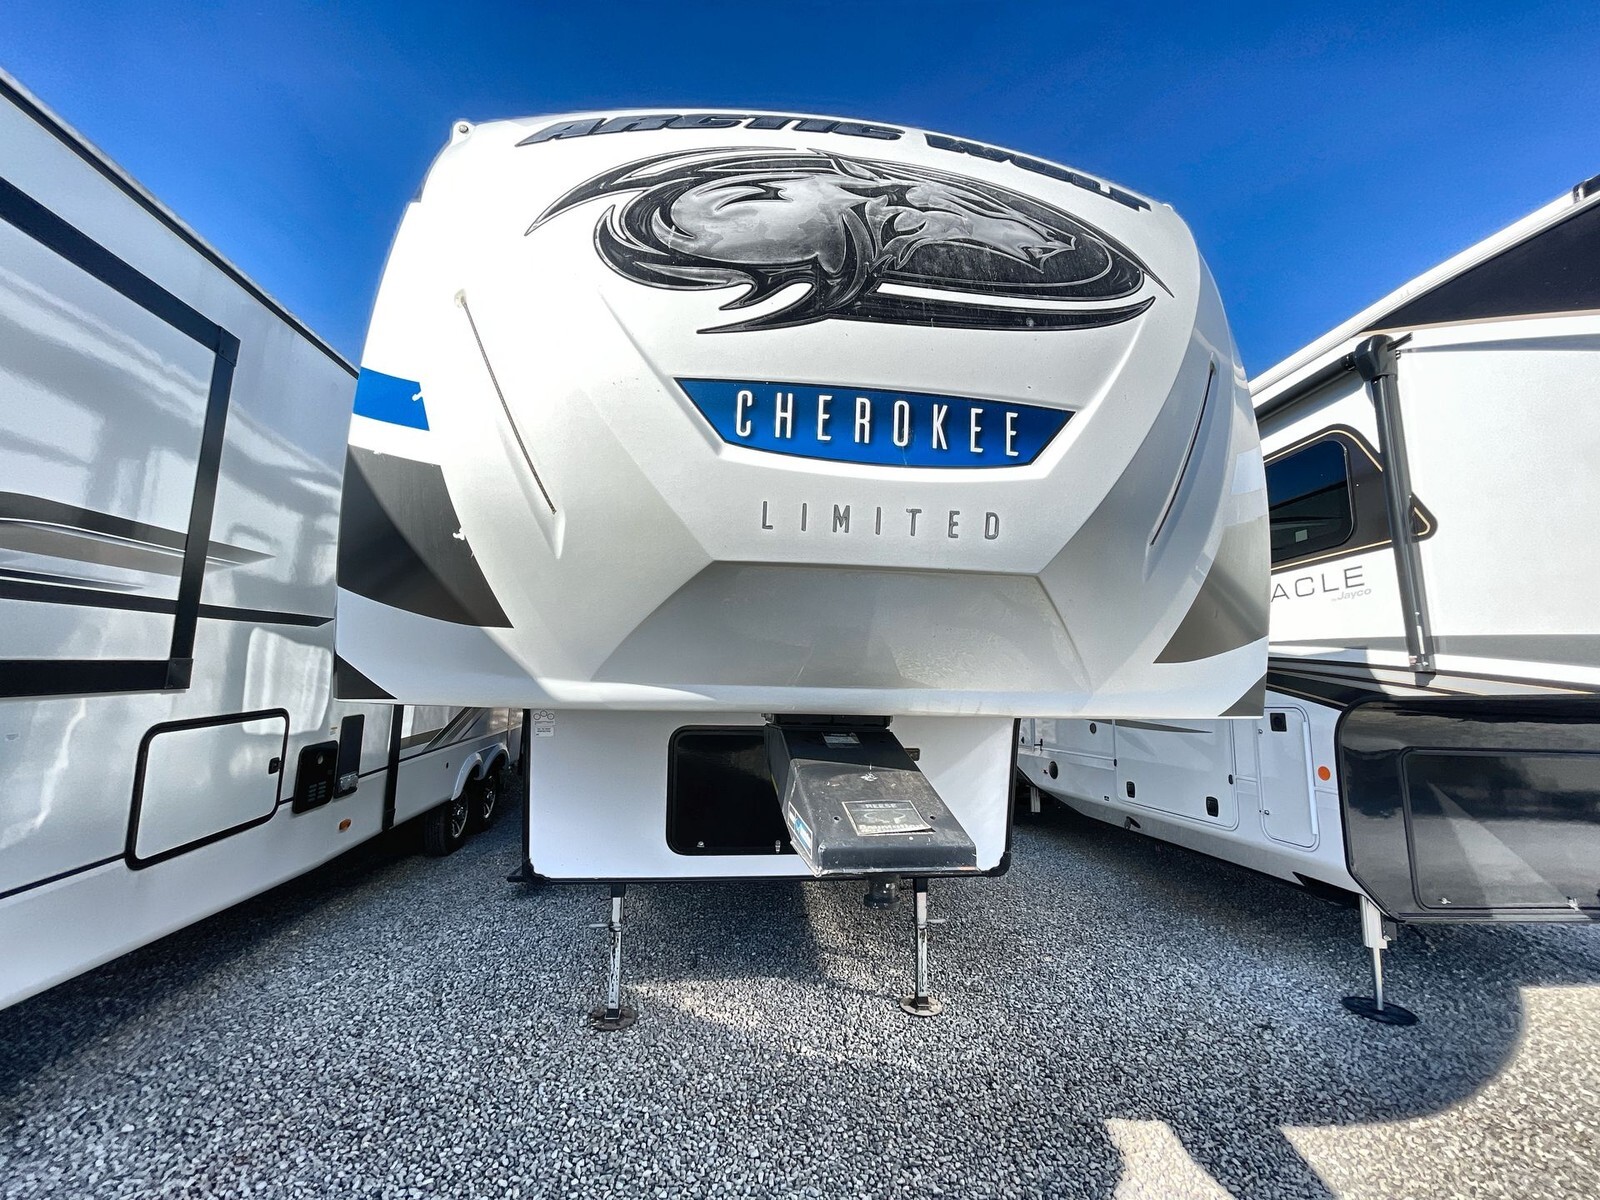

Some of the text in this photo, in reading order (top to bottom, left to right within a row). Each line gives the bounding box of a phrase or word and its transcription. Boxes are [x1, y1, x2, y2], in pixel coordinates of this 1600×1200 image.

[514, 113, 1152, 213] ARCTIC WOLF
[735, 389, 1019, 457] CHEROKEE
[761, 500, 1001, 541] LIMITED
[1337, 588, 1372, 601] Jayco
